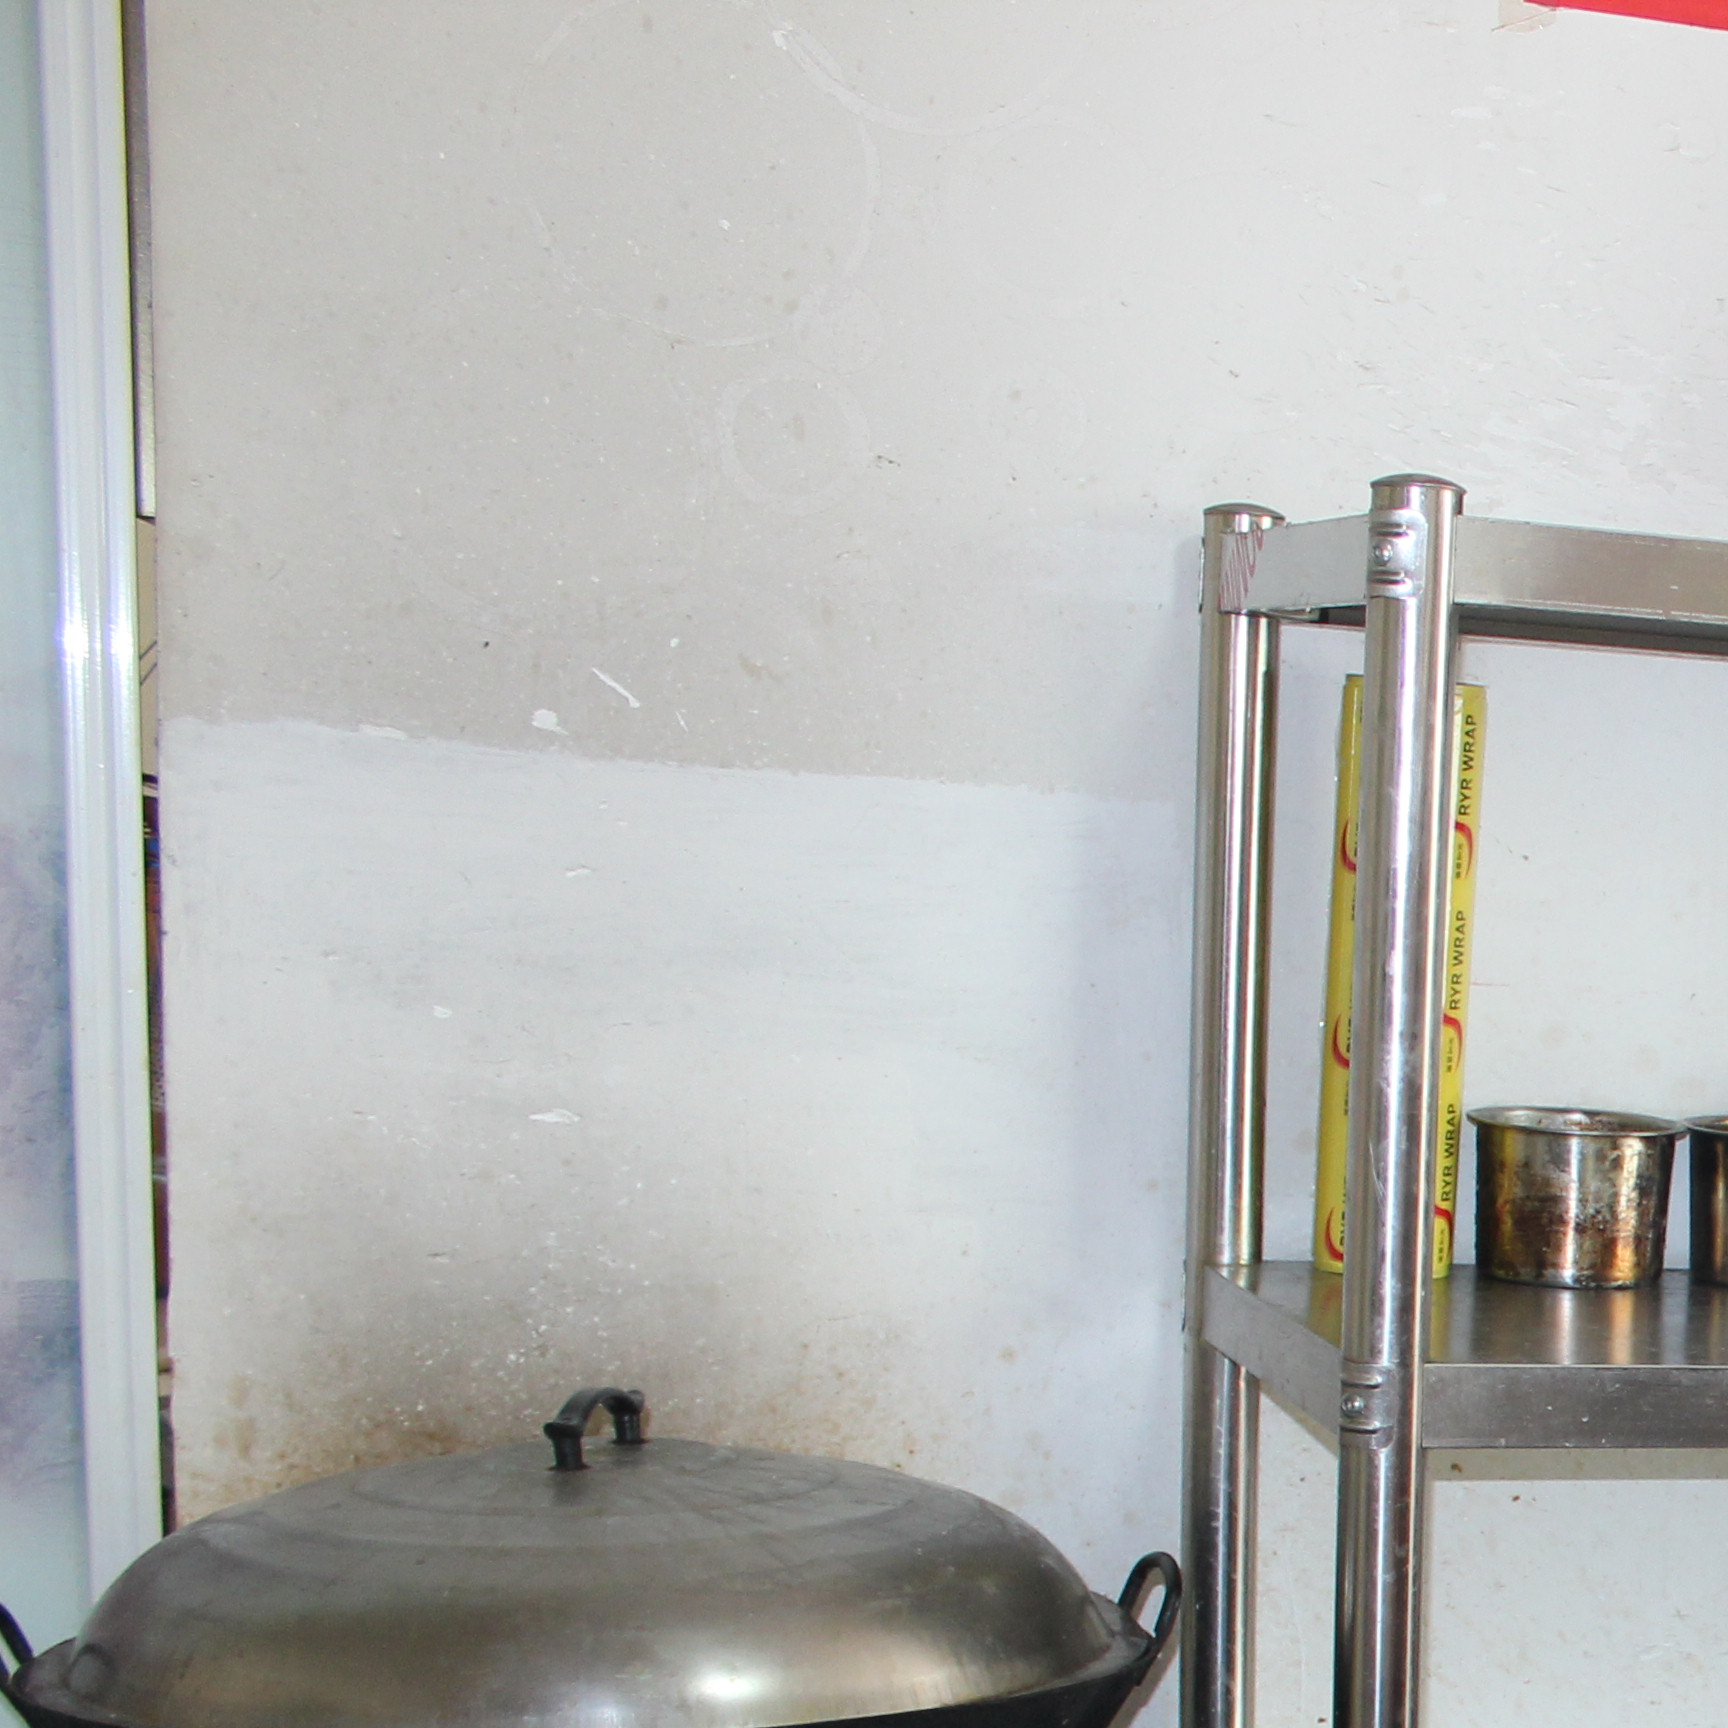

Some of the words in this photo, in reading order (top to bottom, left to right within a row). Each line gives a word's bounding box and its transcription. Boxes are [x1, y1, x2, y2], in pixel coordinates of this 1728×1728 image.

[1462, 714, 1477, 772] WRAP
[1458, 777, 1472, 817] RYR
[1452, 909, 1465, 967] WRAP
[1449, 972, 1462, 1010] RYR
[1444, 1103, 1457, 1159] WRAP
[1440, 1165, 1454, 1202] RYR
